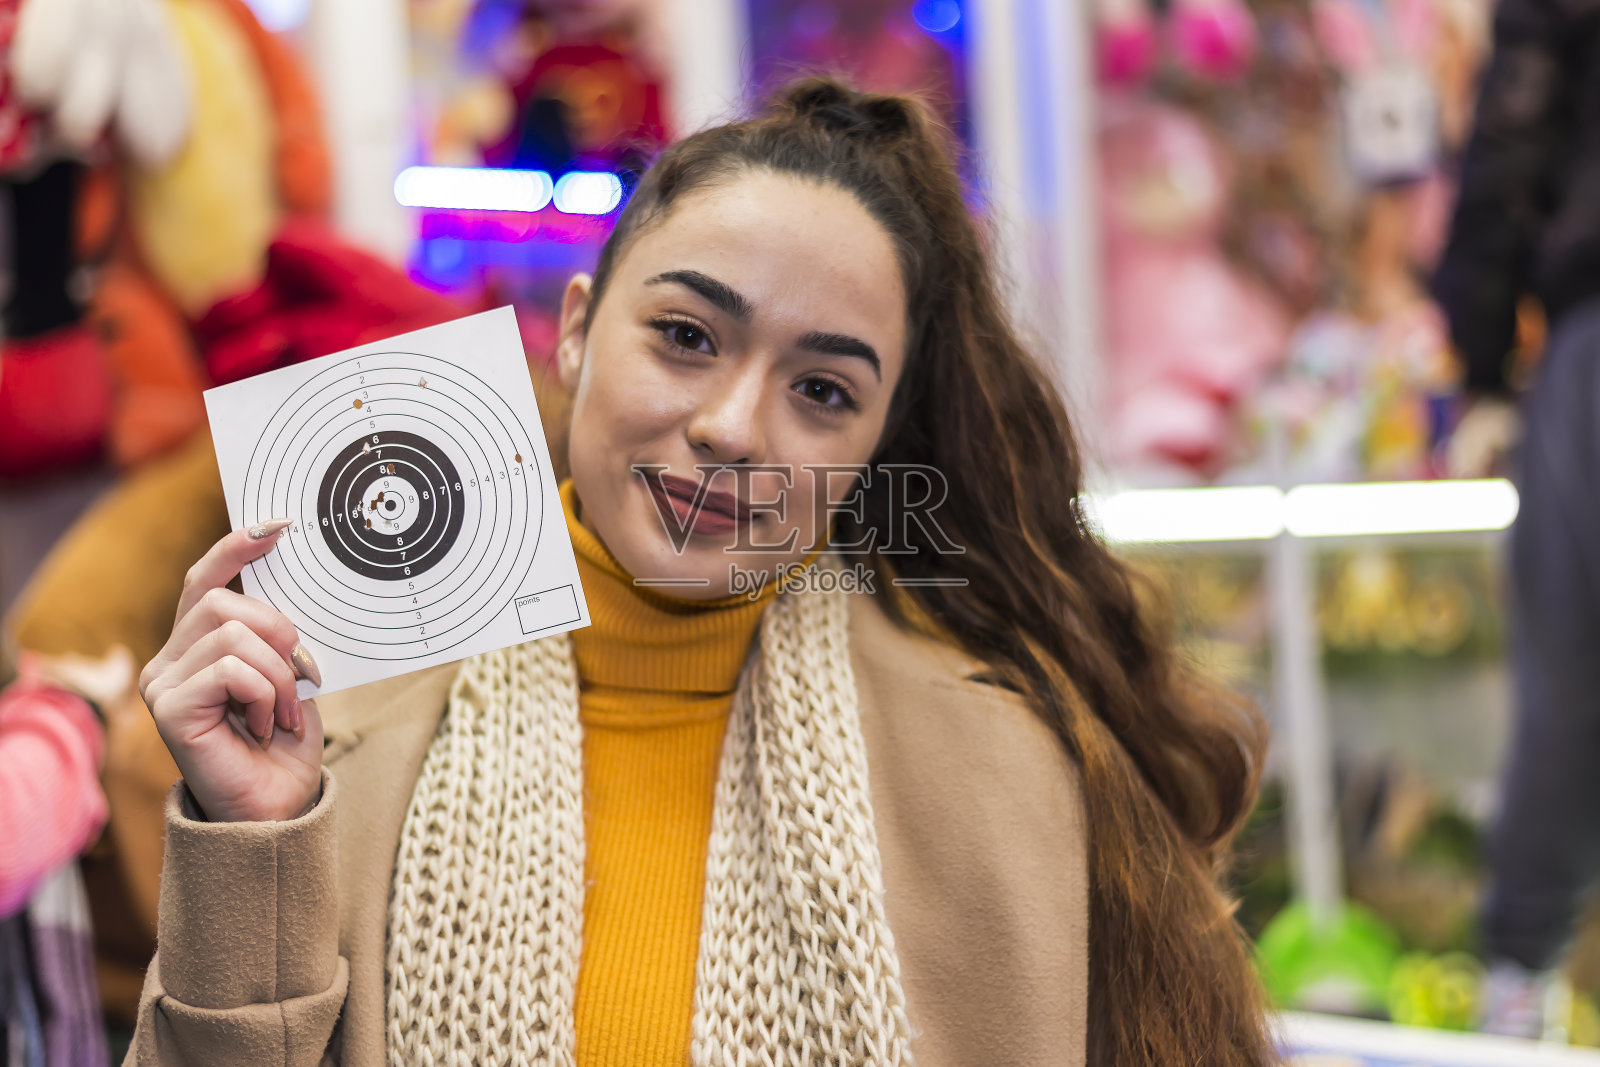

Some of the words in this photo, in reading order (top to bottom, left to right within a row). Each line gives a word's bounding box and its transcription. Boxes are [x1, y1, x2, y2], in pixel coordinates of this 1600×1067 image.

[360, 376, 366, 384] 2
[372, 434, 380, 444] 6
[376, 450, 382, 459] 7
[380, 465, 386, 474] 8
[423, 491, 429, 499] 8
[440, 486, 445, 495] 7
[455, 482, 461, 491] 6
[470, 479, 476, 487] 5
[308, 522, 313, 530] 5
[322, 518, 328, 526] 6
[337, 513, 342, 522] 7
[352, 510, 358, 518] 8
[397, 537, 403, 546] 8
[400, 552, 406, 560] 7
[404, 566, 410, 576] 6
[408, 582, 415, 590] 5
[518, 596, 540, 608] points
[420, 627, 425, 635] 2
